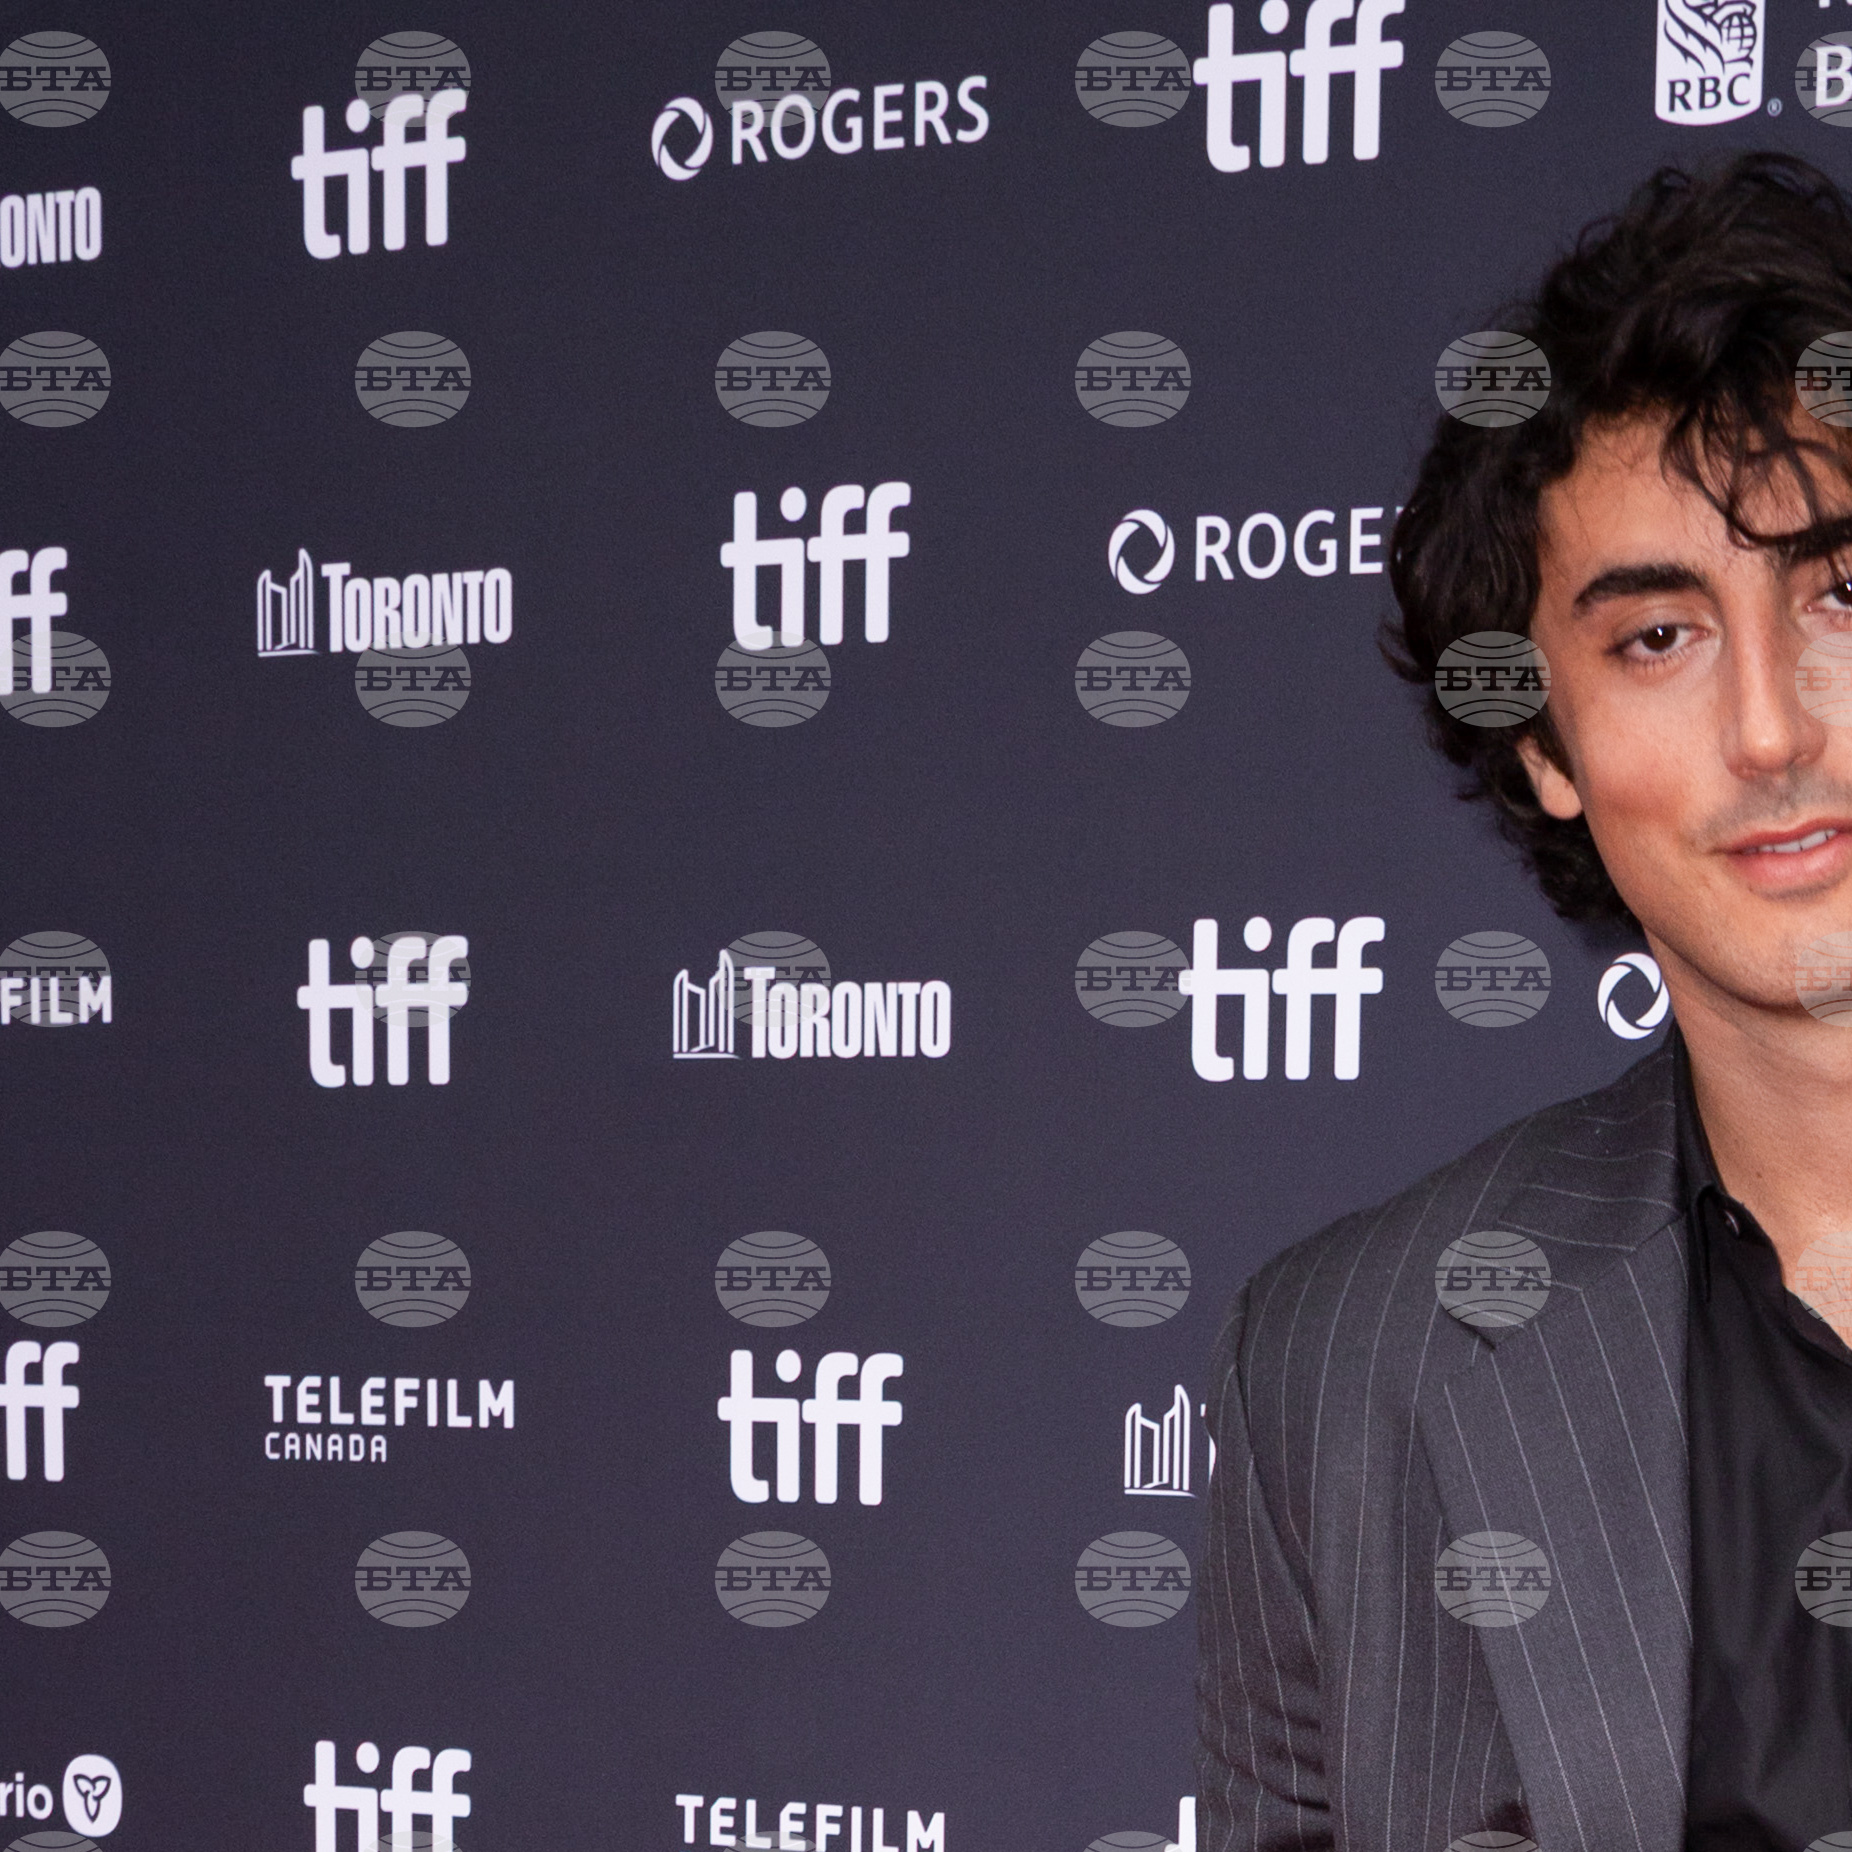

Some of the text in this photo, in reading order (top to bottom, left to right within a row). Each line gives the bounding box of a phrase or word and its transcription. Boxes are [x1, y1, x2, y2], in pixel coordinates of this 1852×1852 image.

[733, 76, 988, 164] ROGERS
[1193, 0, 1404, 172] tiff
[1668, 78, 1752, 112] RBC
[292, 89, 466, 258] tiff
[721, 482, 910, 650] tiff
[1196, 508, 1383, 580] ROGE
[322, 563, 511, 652] TORONTO
[298, 936, 467, 1087] tiff
[744, 966, 951, 1059] TORONTO
[1179, 917, 1385, 1081] tiff
[265, 1376, 513, 1428] TELEFILM
[266, 1433, 386, 1462] CANADA
[718, 1350, 903, 1505] tiff
